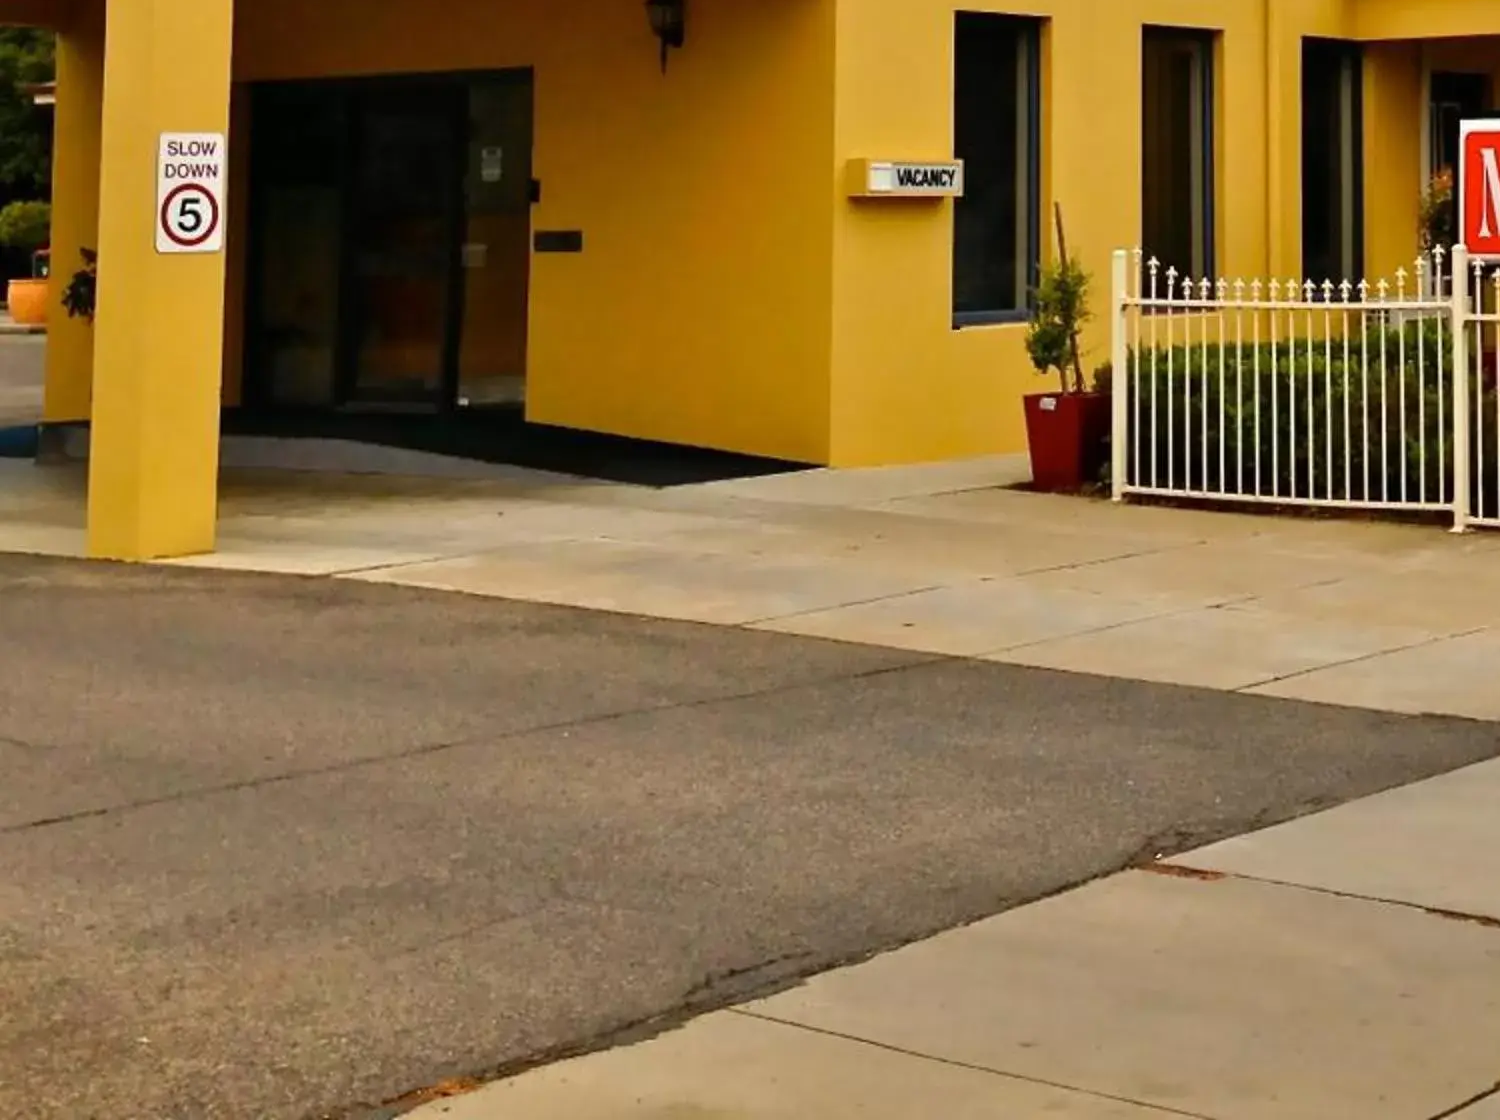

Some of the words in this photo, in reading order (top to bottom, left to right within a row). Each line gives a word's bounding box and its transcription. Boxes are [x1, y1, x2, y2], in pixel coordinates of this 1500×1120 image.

[167, 141, 216, 156] SLOW
[165, 163, 218, 178] DOWN
[897, 168, 955, 186] VACANCY
[178, 197, 202, 232] 5
